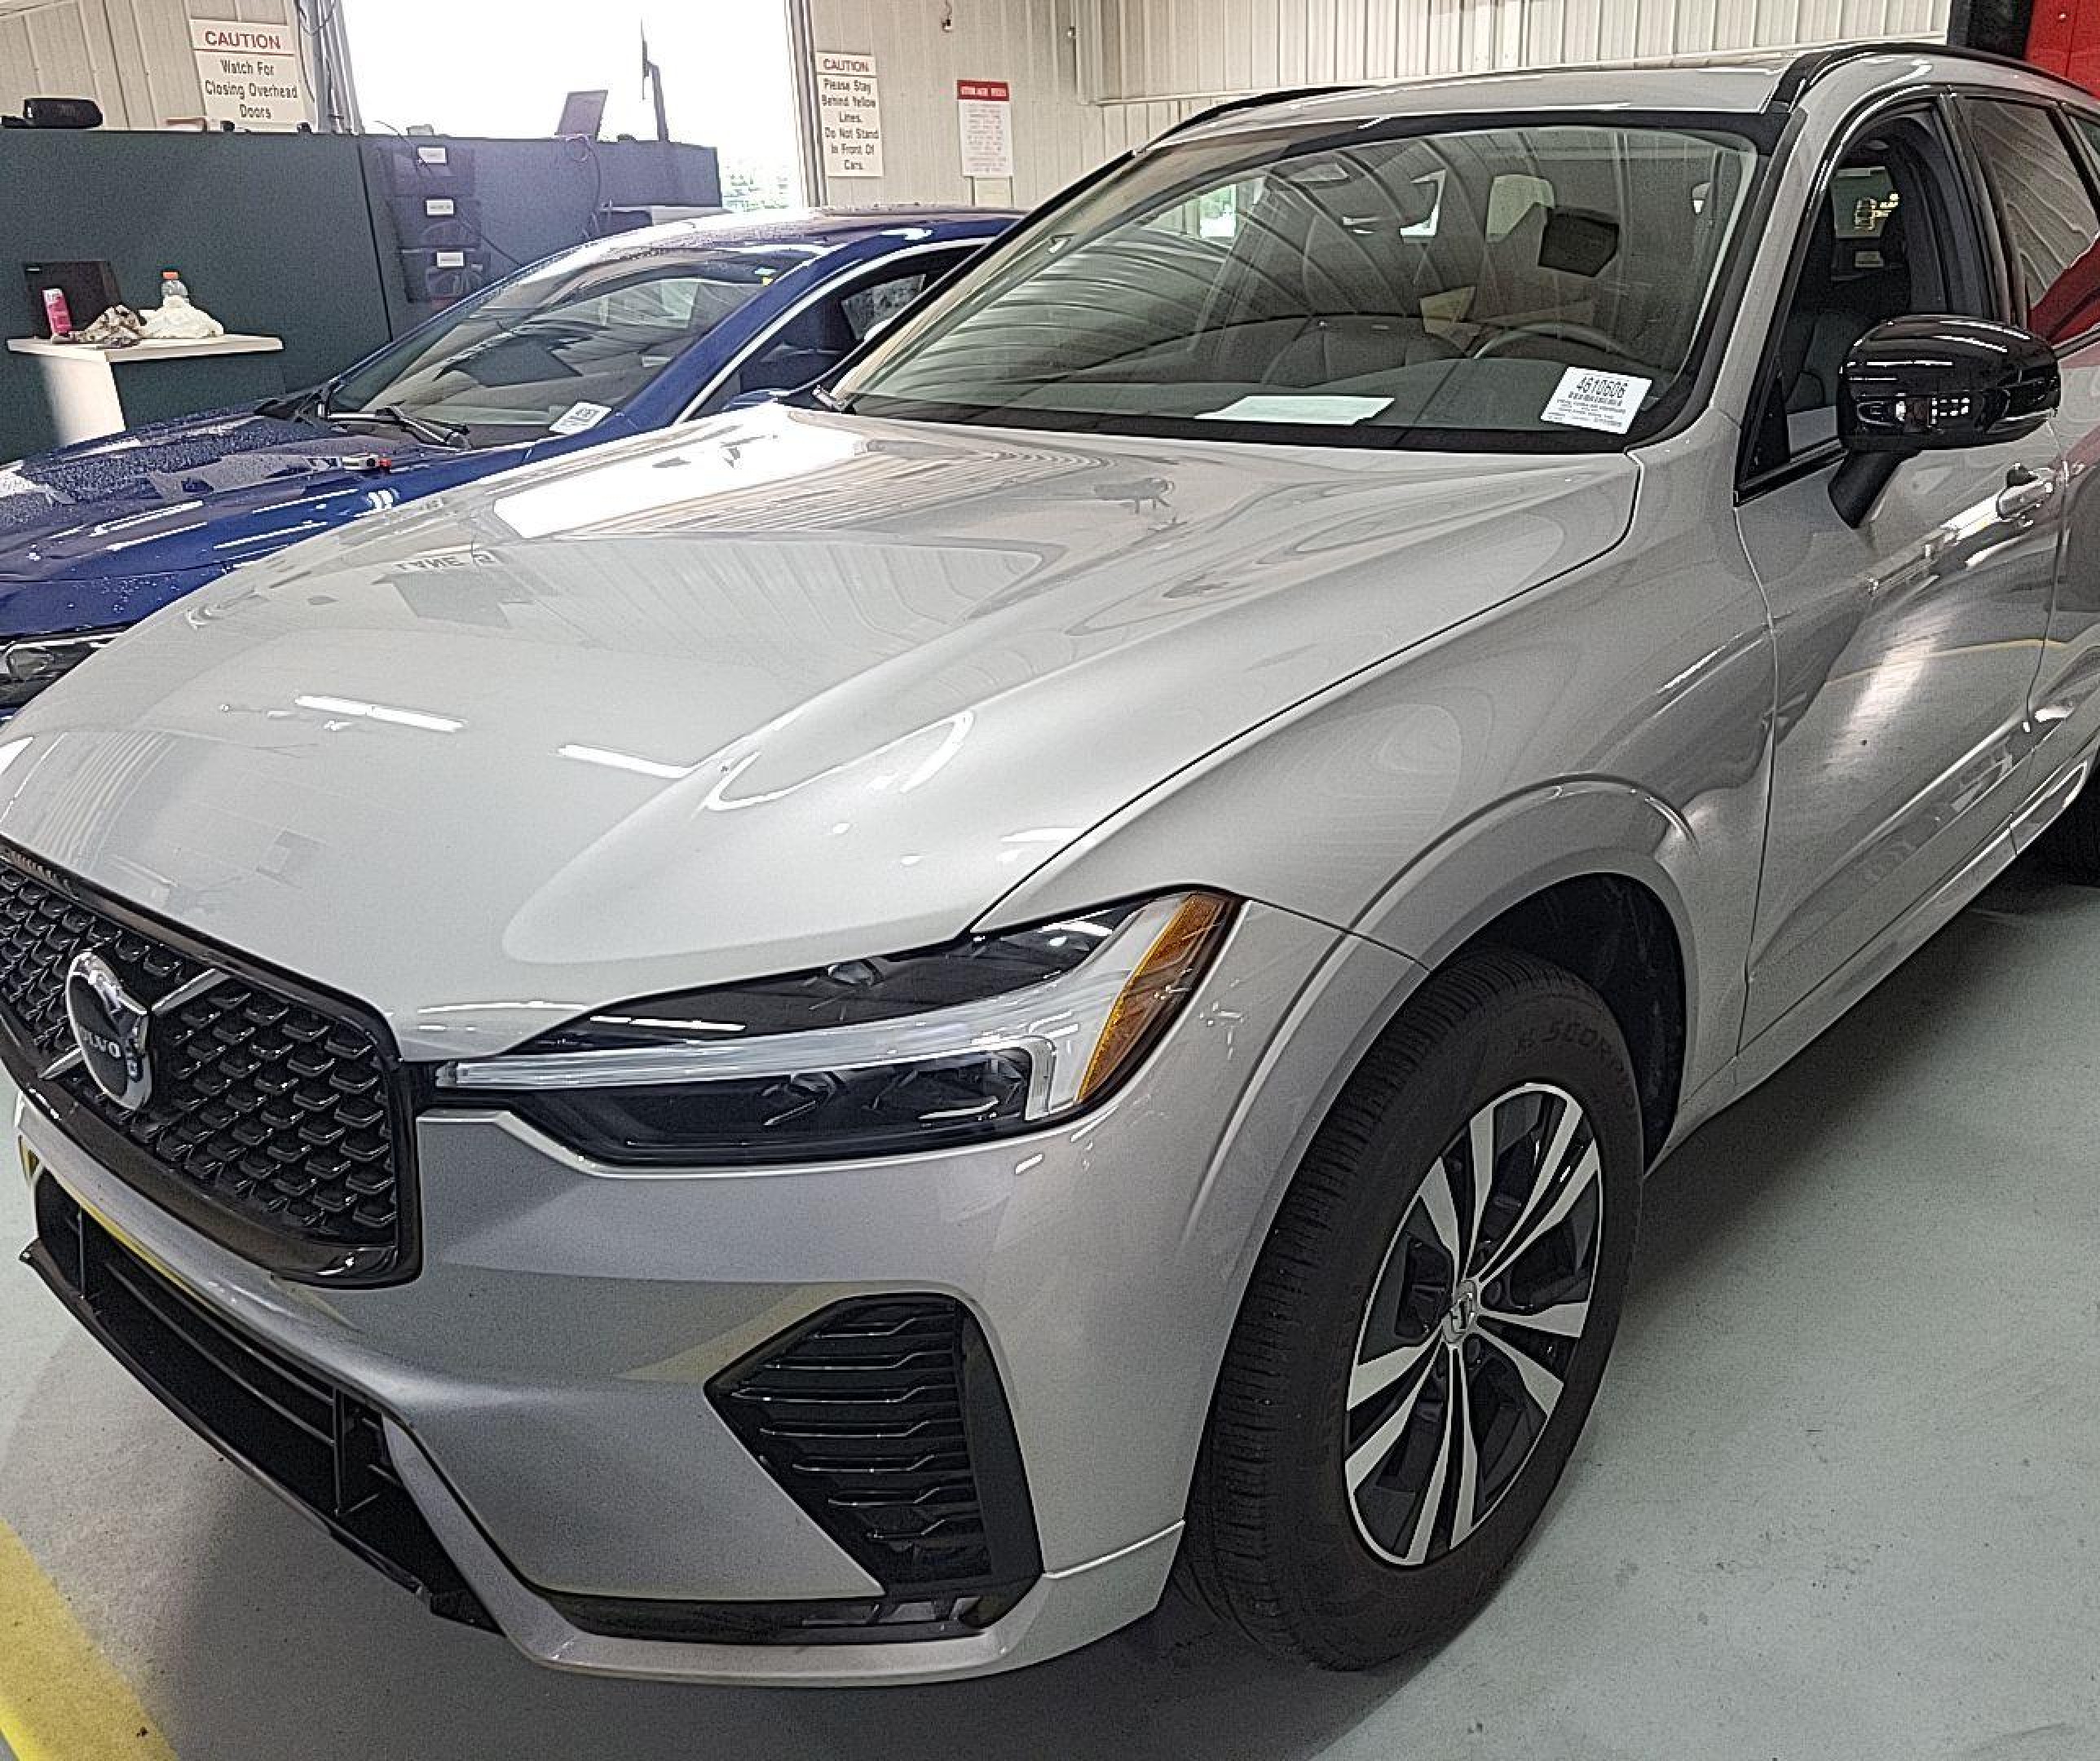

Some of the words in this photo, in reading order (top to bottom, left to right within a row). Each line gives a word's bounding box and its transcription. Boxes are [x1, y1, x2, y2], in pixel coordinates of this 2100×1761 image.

[205, 31, 280, 49] CAUTION
[221, 60, 254, 74] Watch
[258, 62, 275, 76] For
[823, 59, 870, 72] CAUTION
[205, 80, 245, 99] Closing
[249, 82, 298, 98] Overhead
[823, 78, 850, 91] Please
[854, 80, 871, 95] Stay
[822, 95, 849, 106] Behind
[853, 96, 876, 108] Yellow
[240, 104, 271, 119] Doors
[825, 127, 836, 139] Do
[840, 128, 854, 139] Not
[856, 129, 880, 139] Stand
[841, 143, 863, 155] Front
[1576, 376, 1629, 398] 4610606
